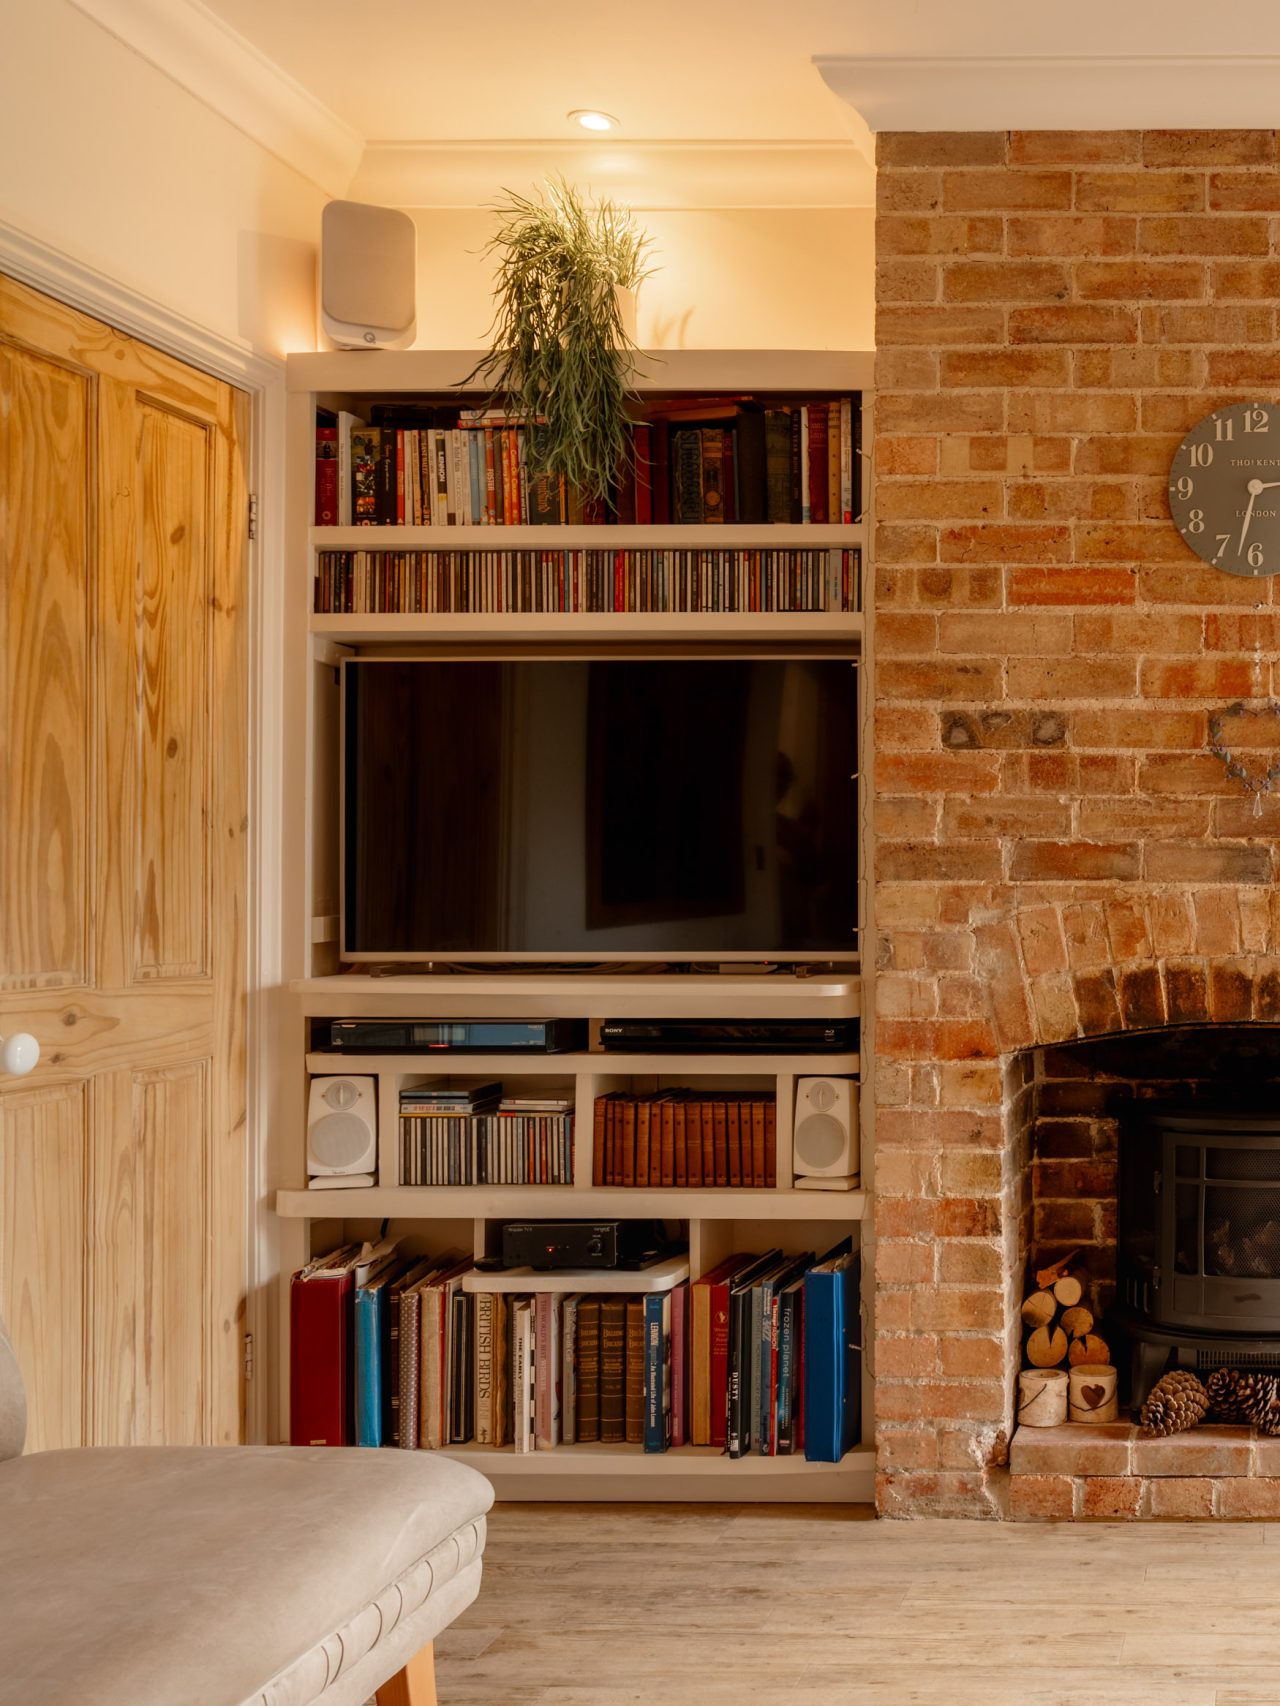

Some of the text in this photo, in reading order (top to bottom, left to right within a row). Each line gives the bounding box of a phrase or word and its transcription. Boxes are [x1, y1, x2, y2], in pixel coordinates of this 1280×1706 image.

[1214, 418, 1234, 441] 11
[1243, 409, 1269, 433] 12
[1189, 442, 1214, 468] 10
[1177, 476, 1194, 500] 9
[1188, 509, 1205, 534] 8
[1215, 534, 1232, 558] 7
[1247, 542, 1264, 567] 6
[650, 1322, 659, 1346] LENNON
[781, 1307, 791, 1341] frozen
[479, 1300, 491, 1399] BRITISH BIRDS
[781, 1344, 791, 1377] planet
